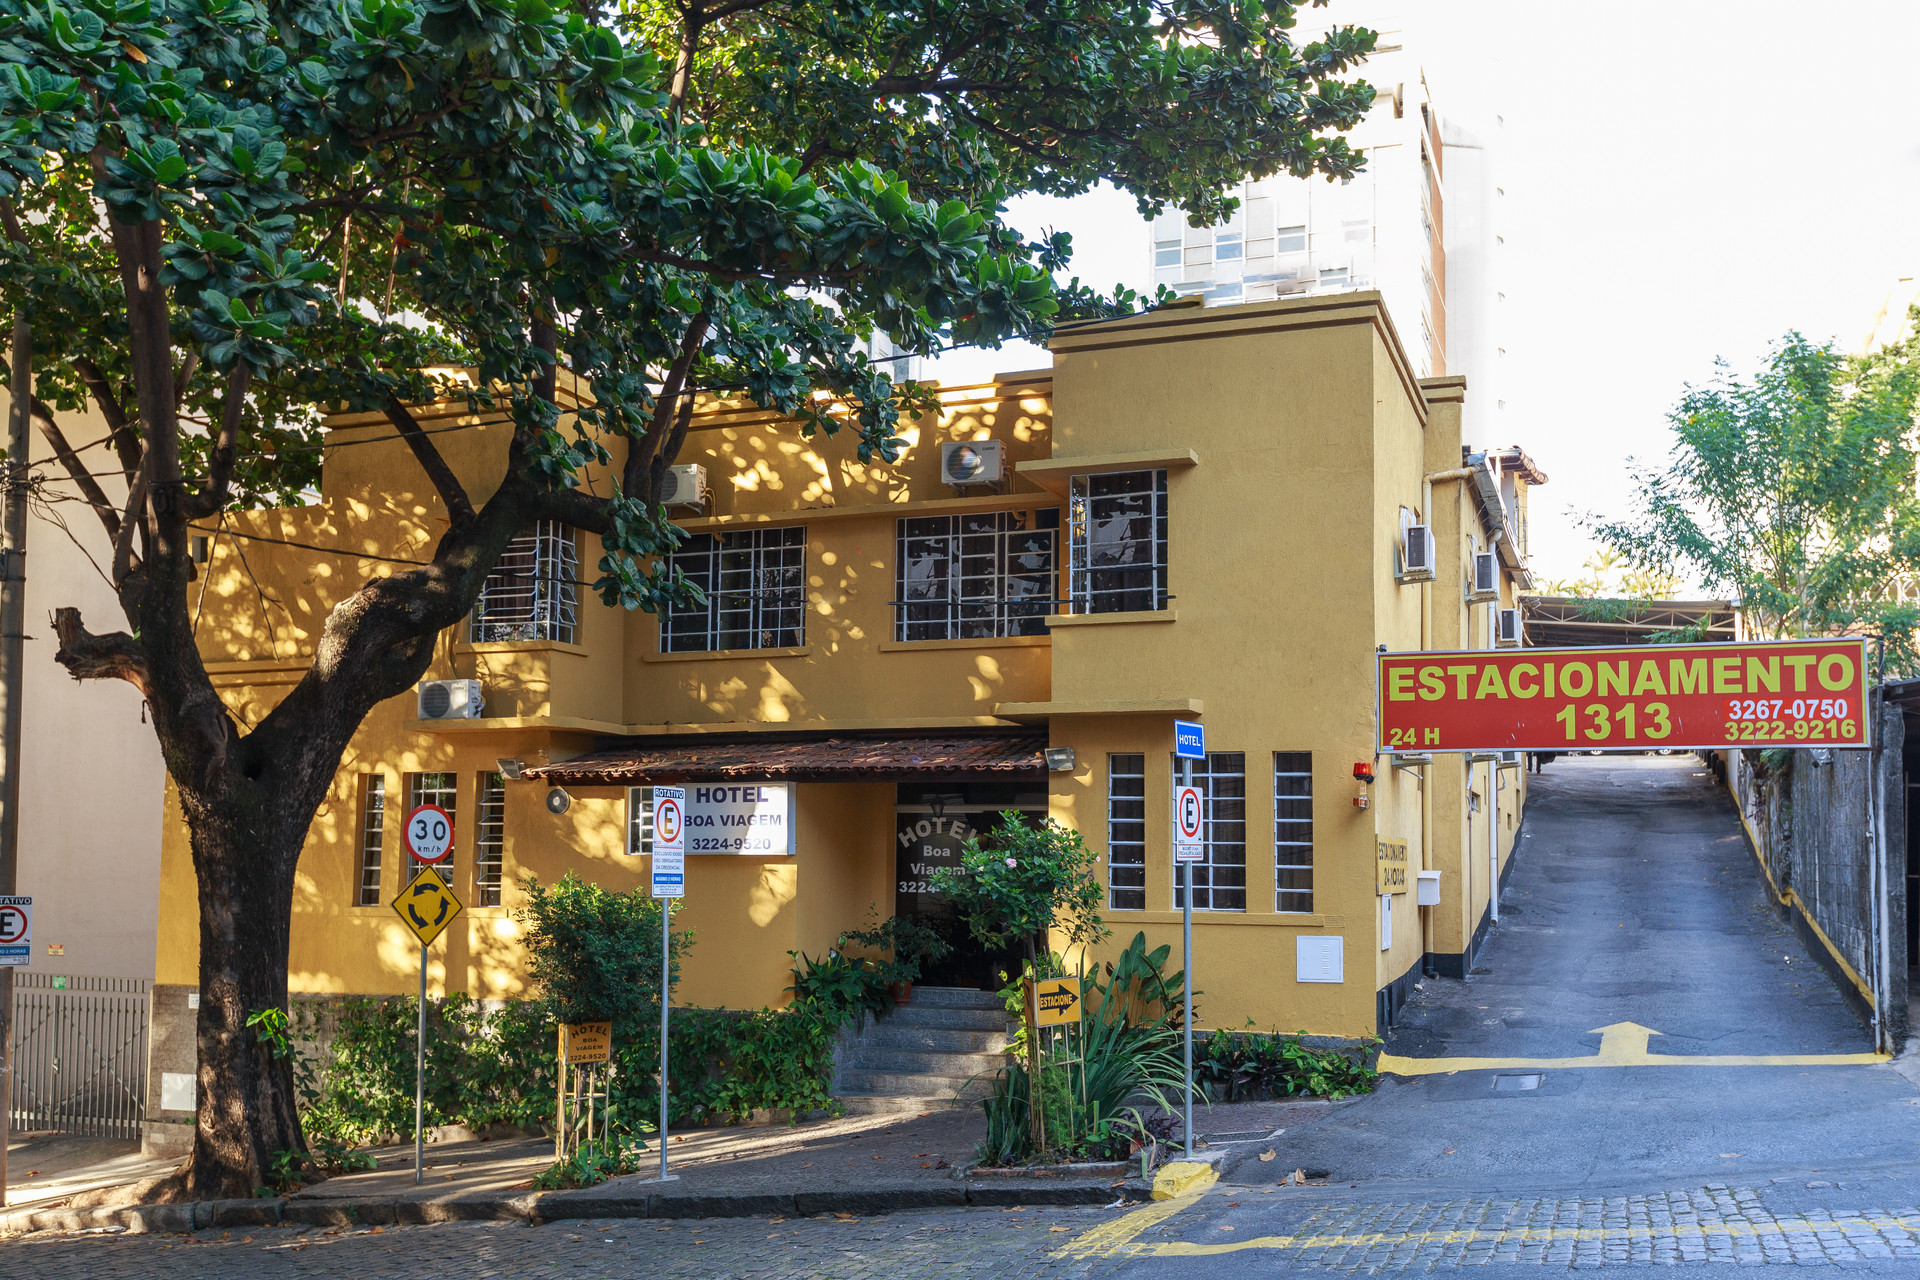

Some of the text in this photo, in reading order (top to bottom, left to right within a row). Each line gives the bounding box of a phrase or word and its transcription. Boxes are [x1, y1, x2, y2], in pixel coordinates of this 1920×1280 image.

[1389, 653, 1855, 701] ESTACIONAMENTO
[1729, 699, 1848, 719] 3267-0750
[1556, 702, 1672, 740] 1313
[1390, 728, 1440, 745] 24 H
[1724, 719, 1857, 741] 3222-9216
[1179, 733, 1201, 746] HOTEL
[655, 789, 684, 799] ROTATIVO
[696, 786, 769, 804] HOTEL
[664, 806, 675, 835] E
[685, 814, 782, 827] BOA VIAGEM
[1186, 798, 1195, 829] E
[415, 819, 446, 842] 30
[417, 845, 442, 853] km/h
[692, 837, 771, 851] 3224-9520
[923, 845, 951, 857] Boa
[910, 863, 966, 875] Viam
[0, 912, 15, 936] E
[1040, 993, 1073, 1009] ESTACIONE
[571, 1025, 607, 1039] HOTEL
[570, 1052, 607, 1062] 3224-9520
